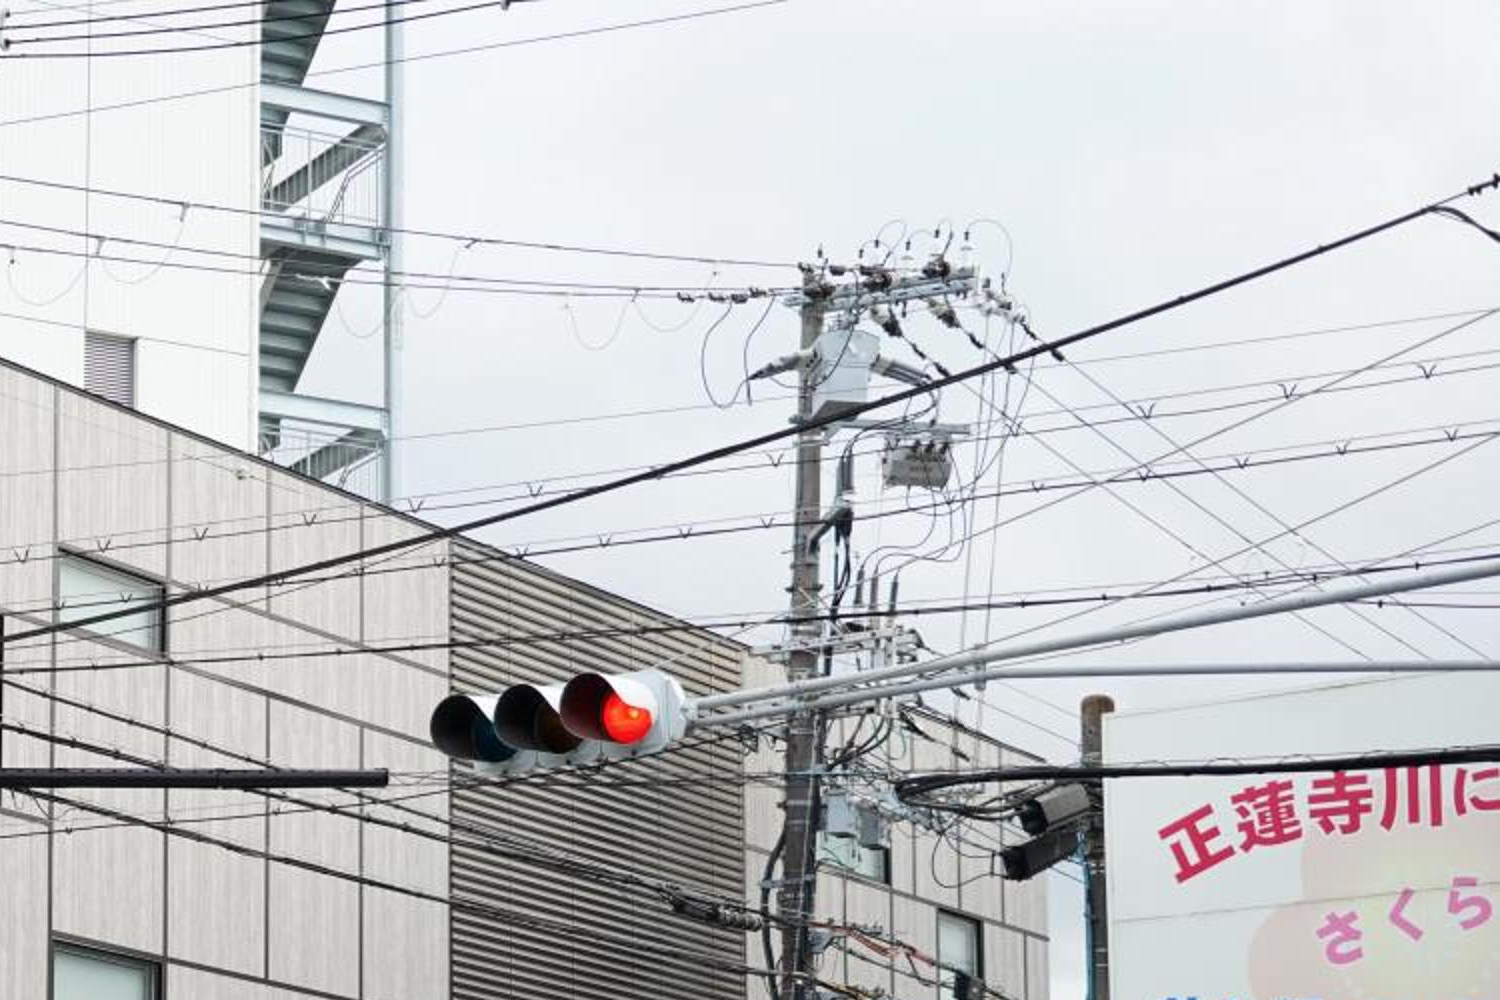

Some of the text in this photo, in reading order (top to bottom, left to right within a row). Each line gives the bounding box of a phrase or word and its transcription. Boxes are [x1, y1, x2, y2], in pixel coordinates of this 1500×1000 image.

[1158, 764, 1500, 884] 正蓮寺川に
[1316, 876, 1493, 965] さくら
